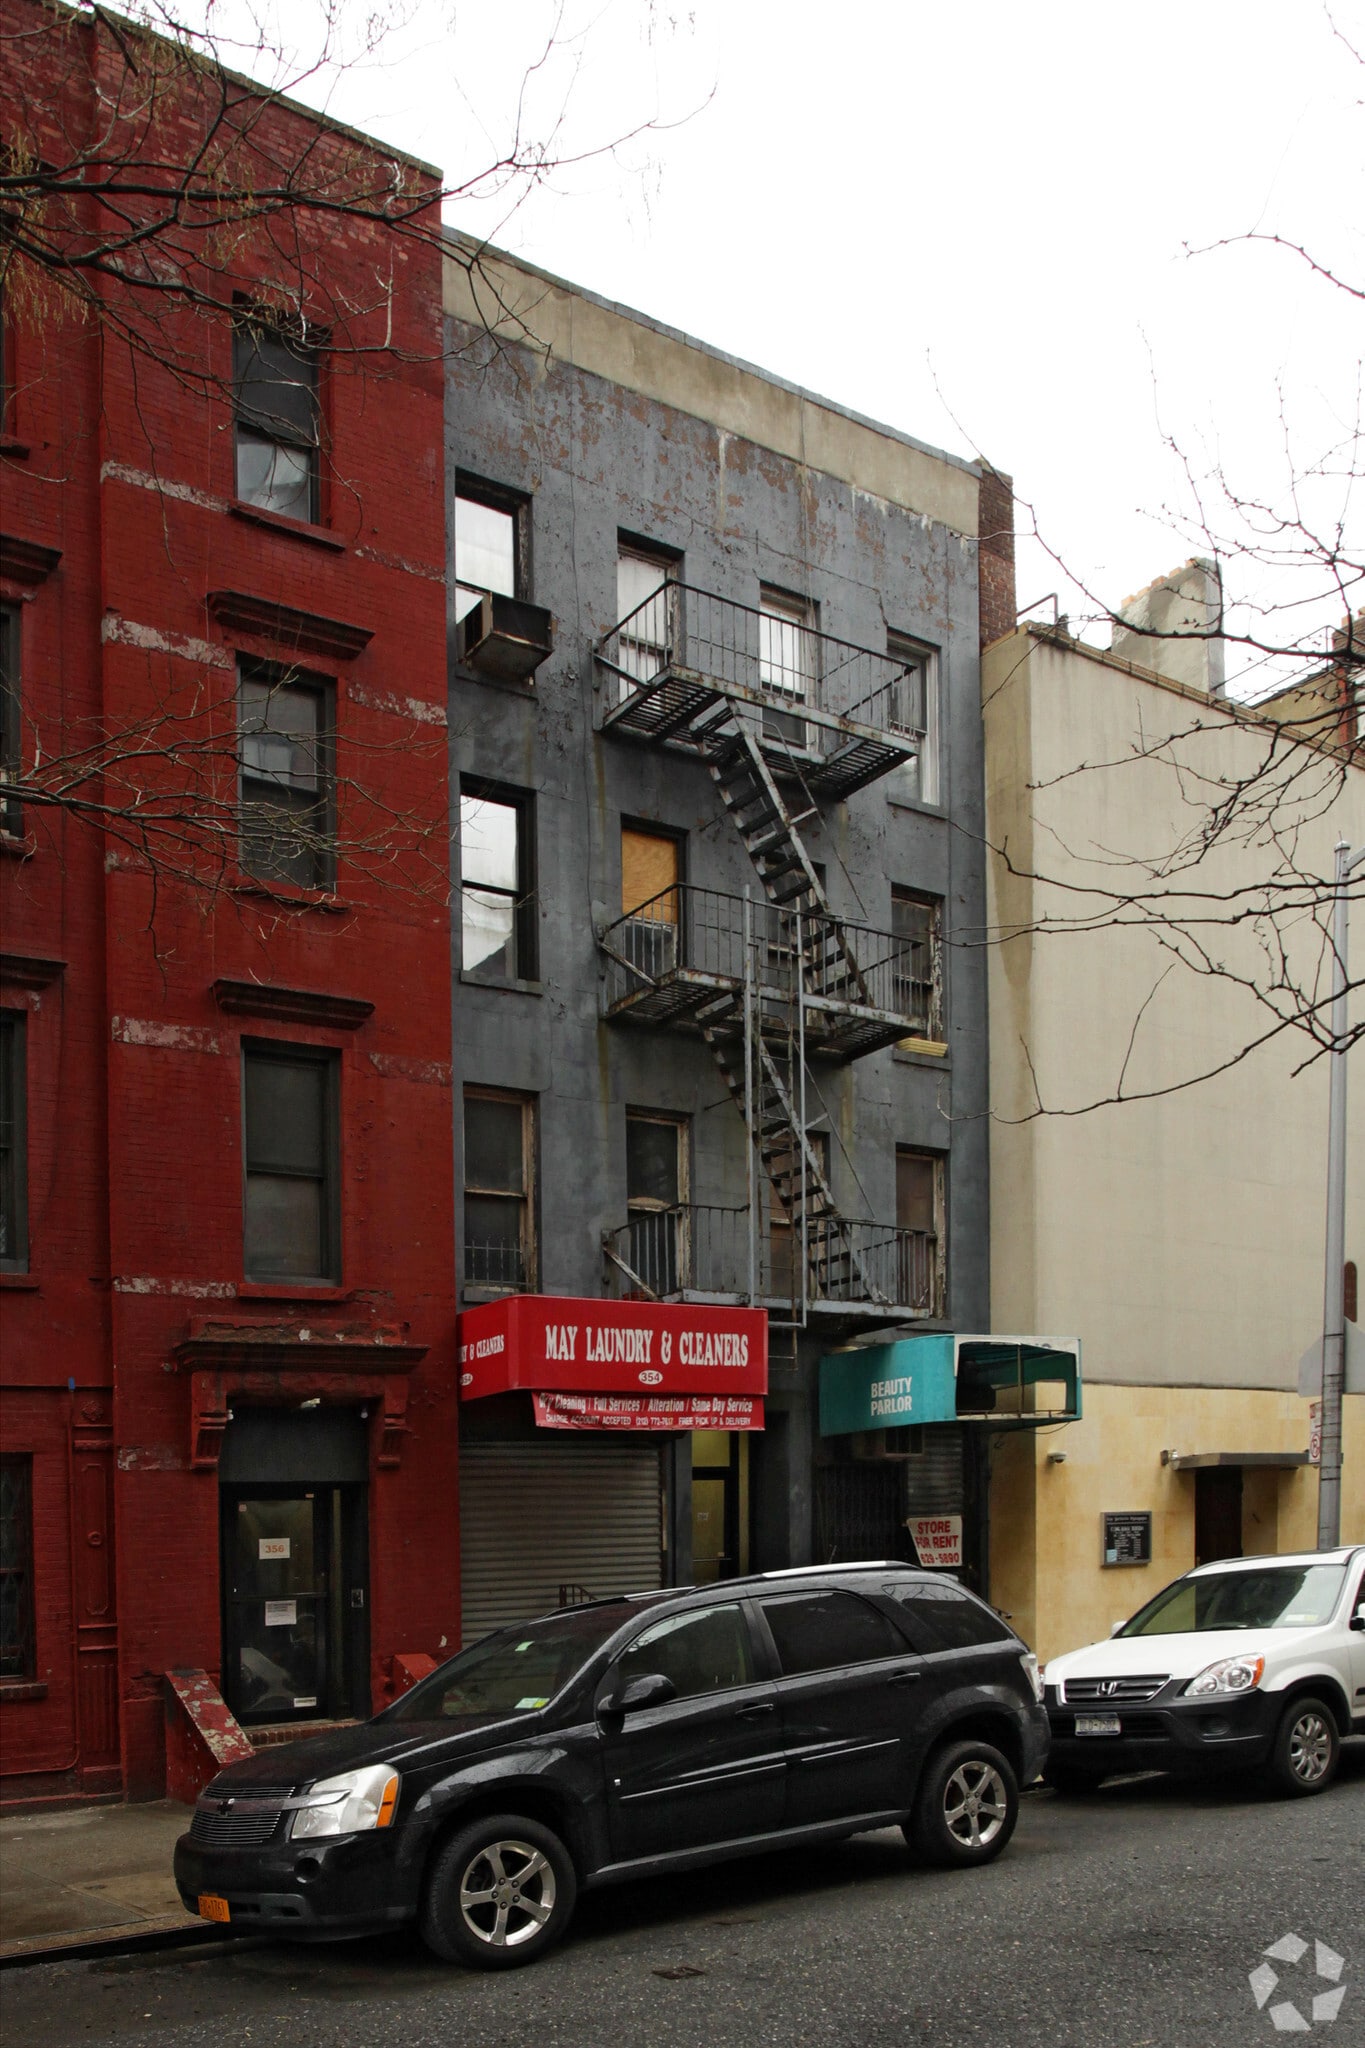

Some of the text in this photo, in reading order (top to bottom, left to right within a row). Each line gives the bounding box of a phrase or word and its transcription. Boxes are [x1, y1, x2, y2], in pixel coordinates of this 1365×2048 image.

[476, 1334, 504, 1359] CLEANERS
[545, 1325, 749, 1367] MAY LAUNDRY & CLEANERS
[640, 1372, 660, 1383] 354
[870, 1376, 913, 1399] BEAUTY
[555, 1394, 586, 1414] Cleaning
[593, 1397, 607, 1411] Full
[609, 1398, 640, 1412] Services
[648, 1398, 684, 1412] Alteration
[691, 1397, 711, 1412] Same
[712, 1397, 726, 1416] Day
[727, 1397, 753, 1413] Service
[870, 1396, 913, 1416] PARLOR
[602, 1415, 632, 1425] ACCEPTED
[678, 1416, 694, 1426] FREE
[695, 1416, 709, 1426] PICK
[725, 1416, 751, 1426] DELIVERY
[917, 1520, 951, 1534] STORE
[265, 1545, 285, 1553] 356
[915, 1535, 959, 1549] FOR RENT
